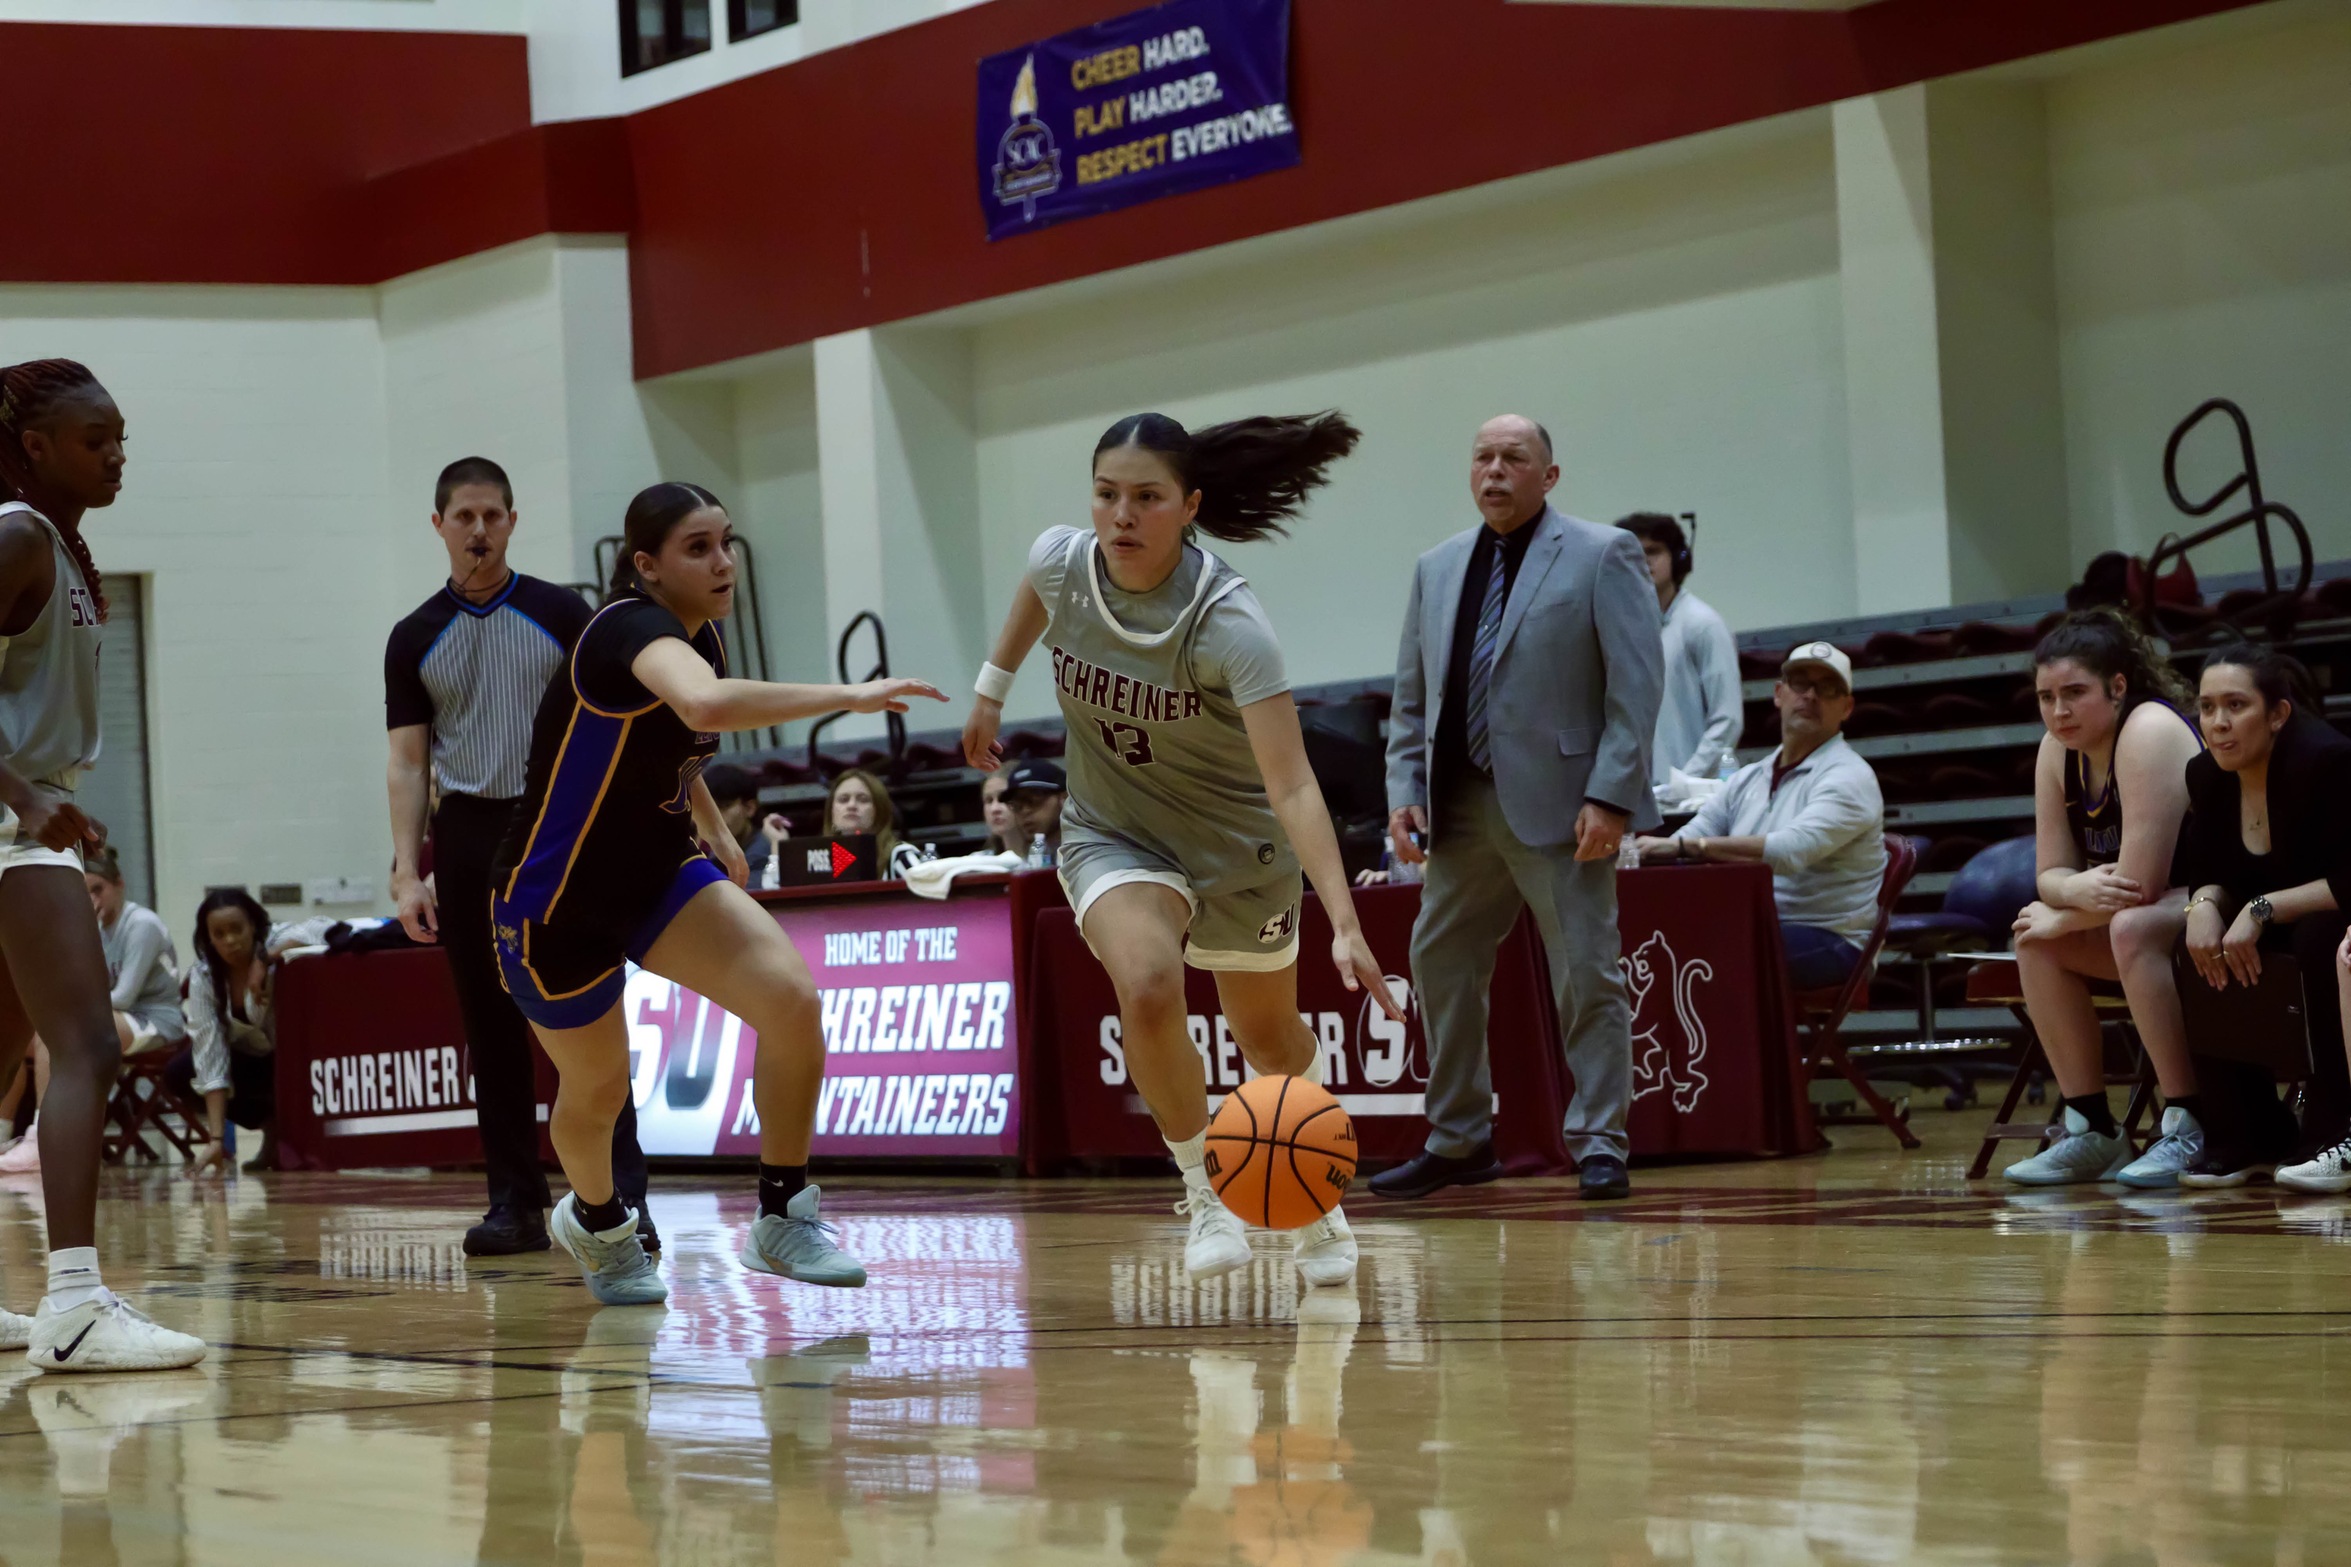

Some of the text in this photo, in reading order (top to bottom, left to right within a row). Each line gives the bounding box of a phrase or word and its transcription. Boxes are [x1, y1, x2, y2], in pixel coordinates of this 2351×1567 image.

[1071, 26, 1210, 91] CHEER HARD.
[1074, 71, 1223, 139] PLAY HARDER.
[1076, 103, 1293, 185] RESPECT EVERYONE.
[1052, 646, 1202, 722] SCHREINER
[1091, 716, 1156, 767] 13
[824, 927, 958, 967] HOME OF THE
[1258, 901, 1296, 943] SU
[818, 981, 1011, 1053] HREINER
[310, 1046, 460, 1115] SCHREINER
[731, 1073, 1014, 1136] MNTAINEERS
